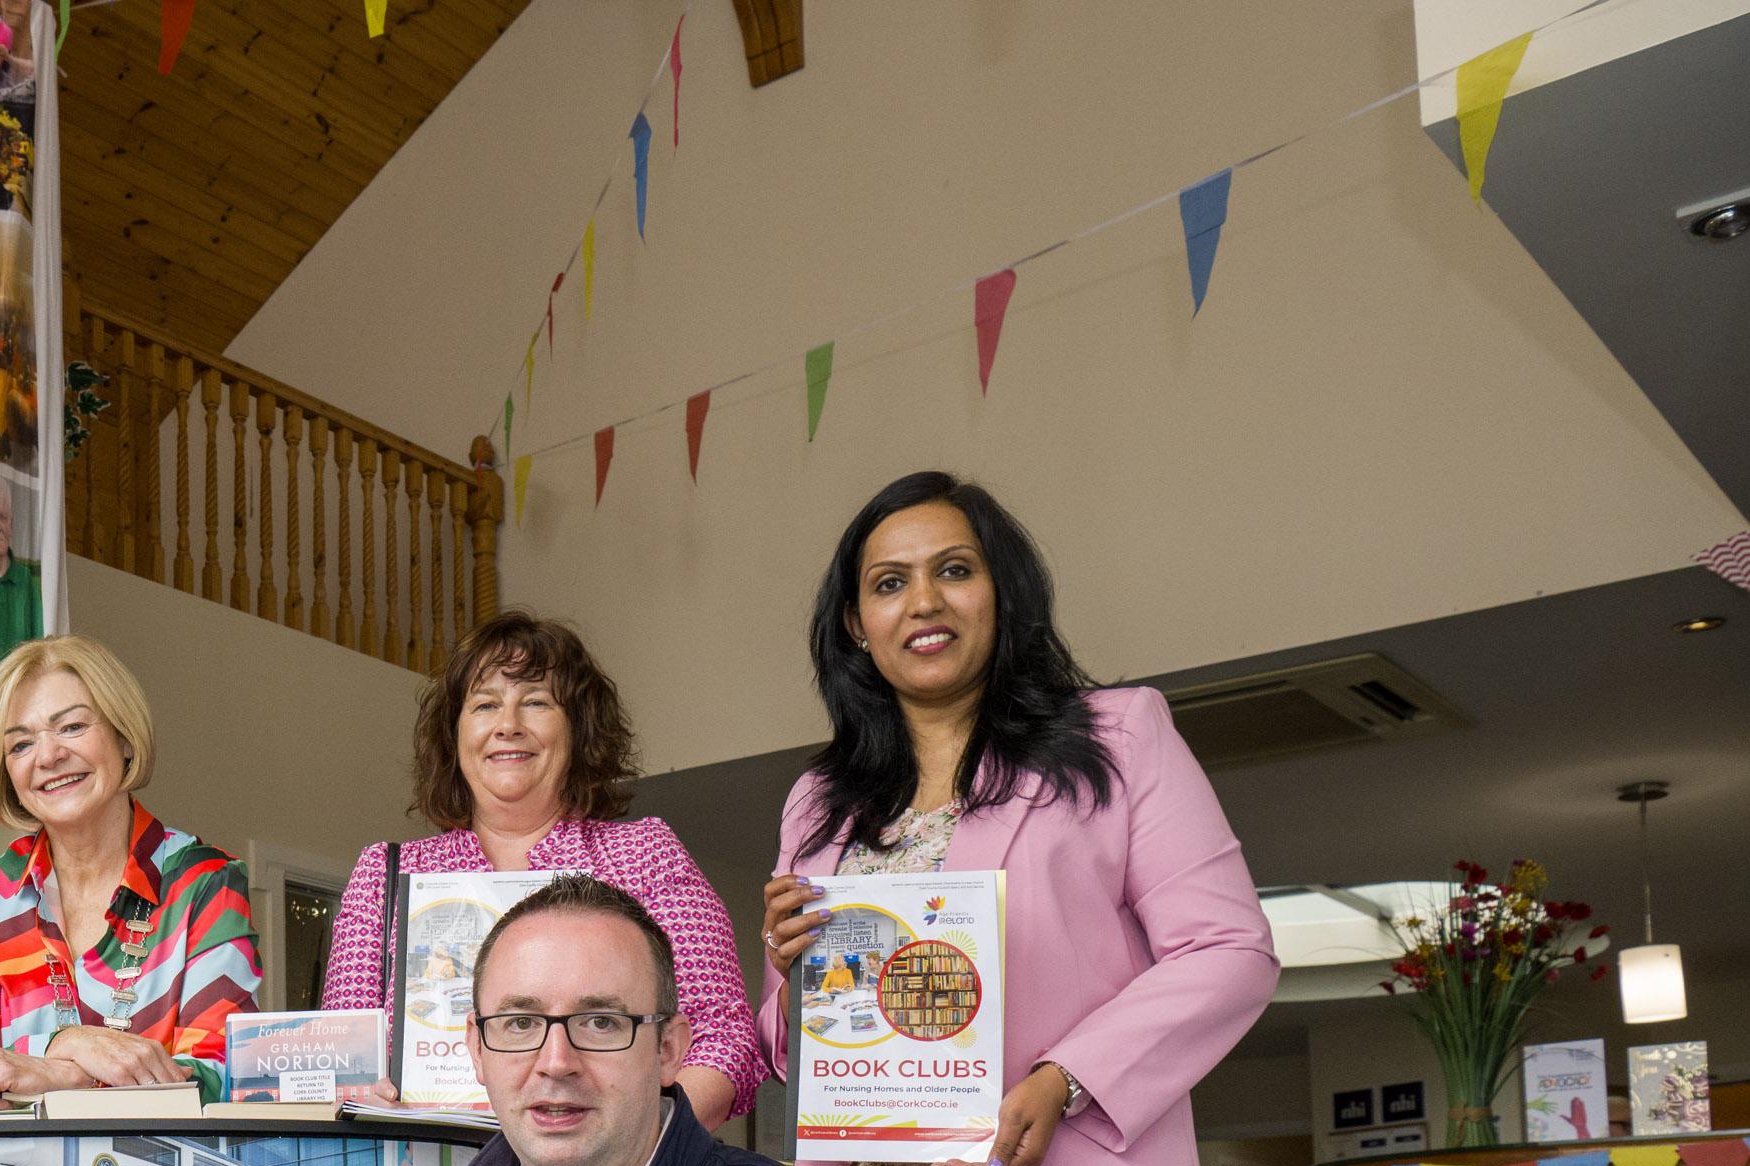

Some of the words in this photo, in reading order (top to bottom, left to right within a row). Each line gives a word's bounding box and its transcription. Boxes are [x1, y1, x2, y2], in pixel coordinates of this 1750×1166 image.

[831, 936, 872, 945] LIBRARY
[847, 942, 884, 951] question
[257, 1023, 306, 1038] Forever
[310, 1021, 348, 1035] Home
[270, 1042, 335, 1053] GRAHAM
[416, 1041, 467, 1057] BOO
[257, 1053, 349, 1071] NORTON
[440, 1064, 470, 1072] Nursing
[813, 1060, 890, 1078] BOOK
[898, 1060, 987, 1078] CLUBS
[839, 1085, 871, 1093] Nursing
[950, 1086, 980, 1095] People
[834, 1099, 958, 1109] BookClubs@CorkCoCo.ie
